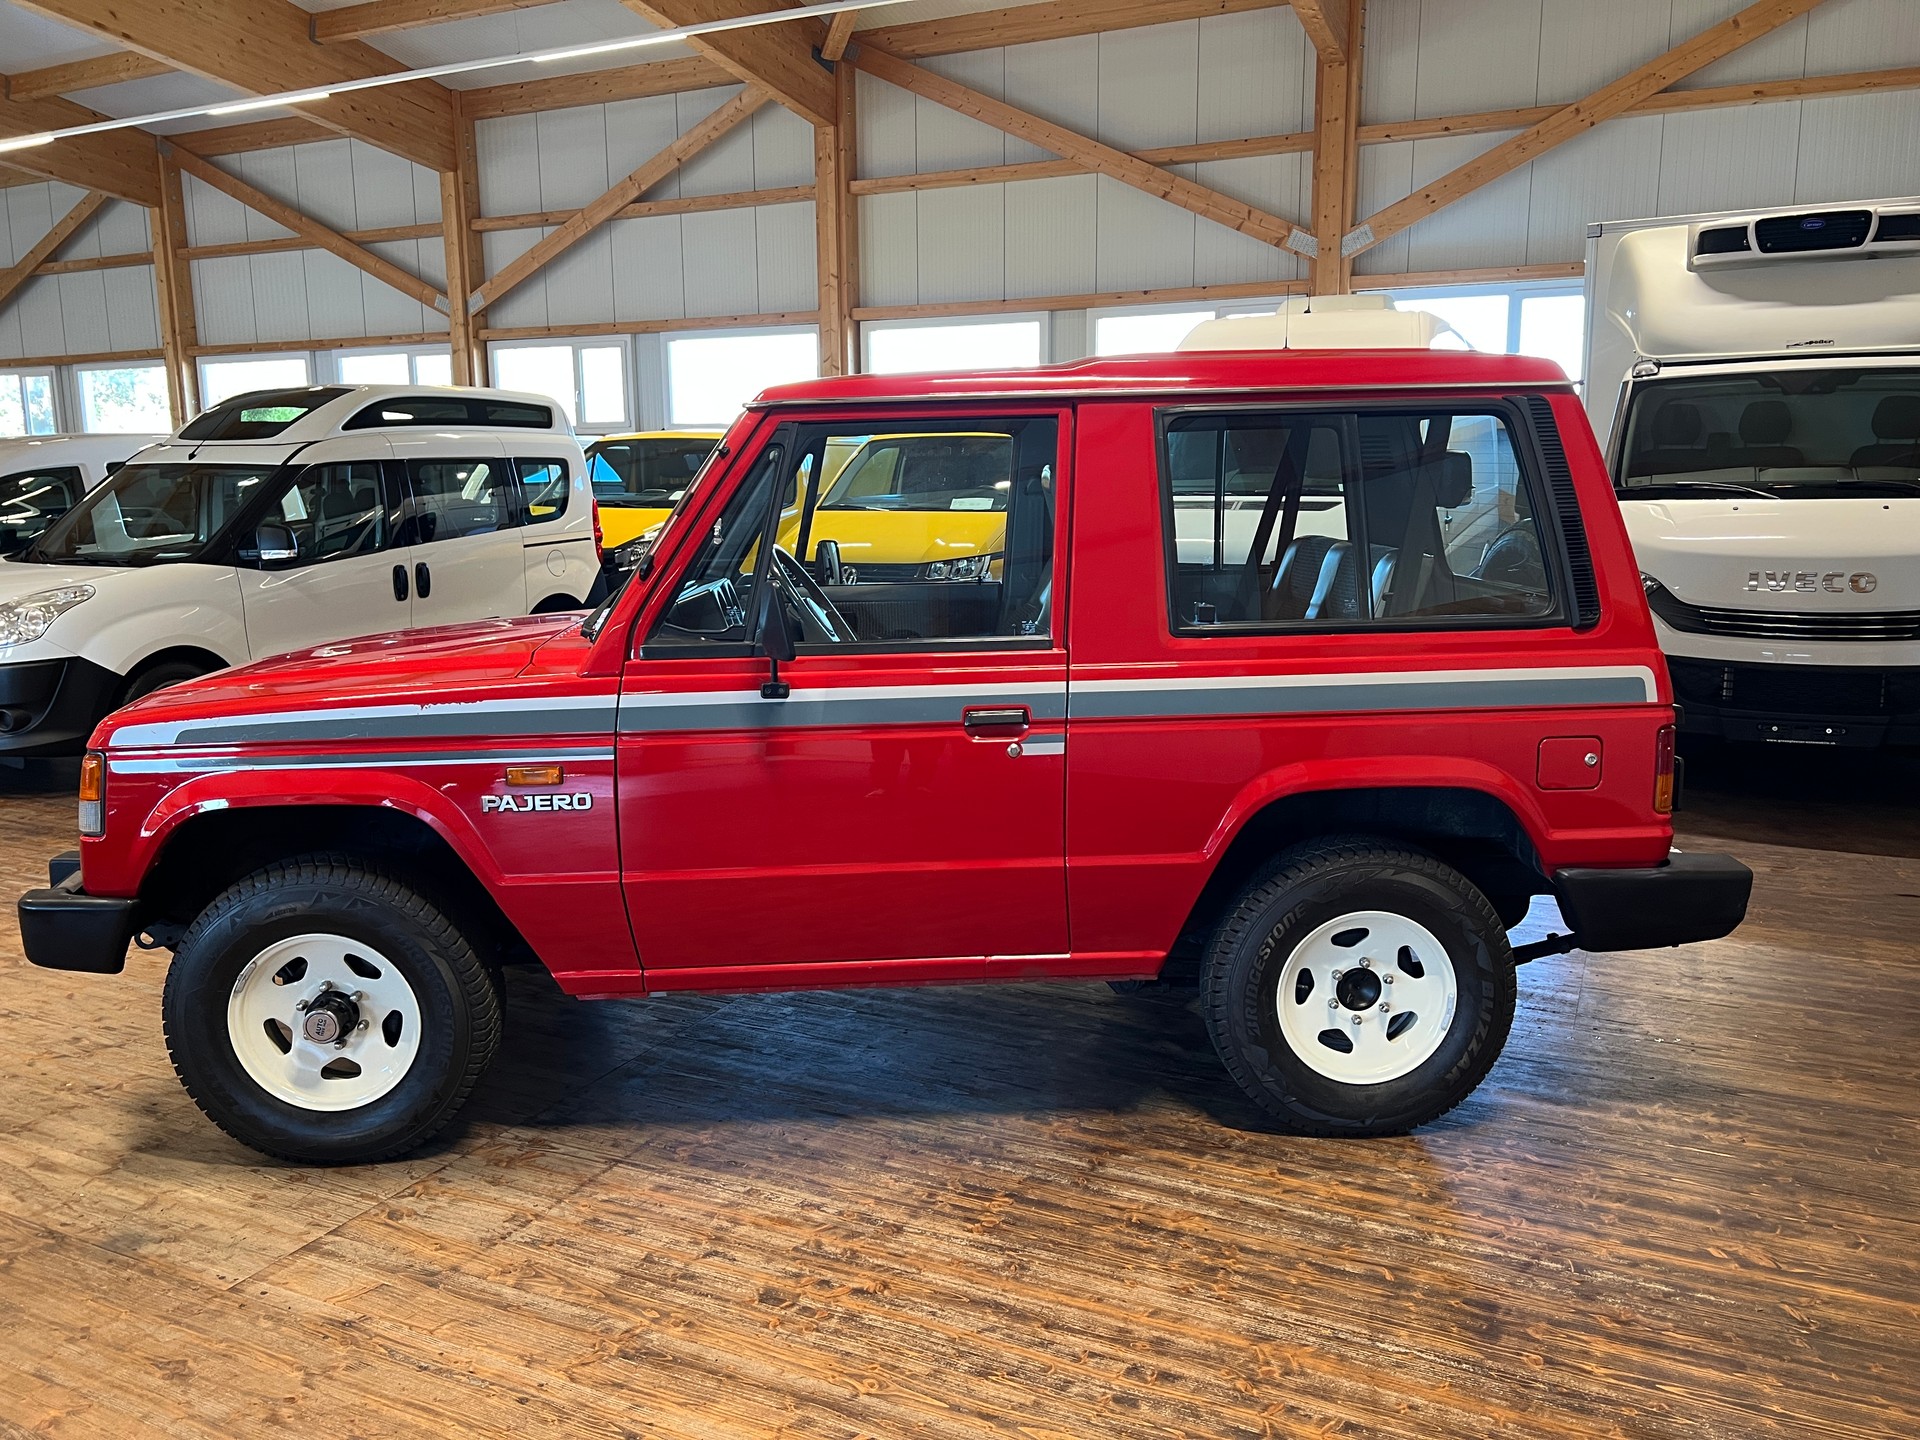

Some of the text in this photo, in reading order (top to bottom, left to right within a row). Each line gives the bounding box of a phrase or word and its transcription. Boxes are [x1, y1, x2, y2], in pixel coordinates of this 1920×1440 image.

[1747, 571, 1877, 593] IVECO
[481, 793, 593, 813] PAJERO
[1243, 902, 1307, 1037] BRIDGESTONE
[315, 1018, 324, 1036] AUTO
[1444, 980, 1496, 1087] BLIZZAK
